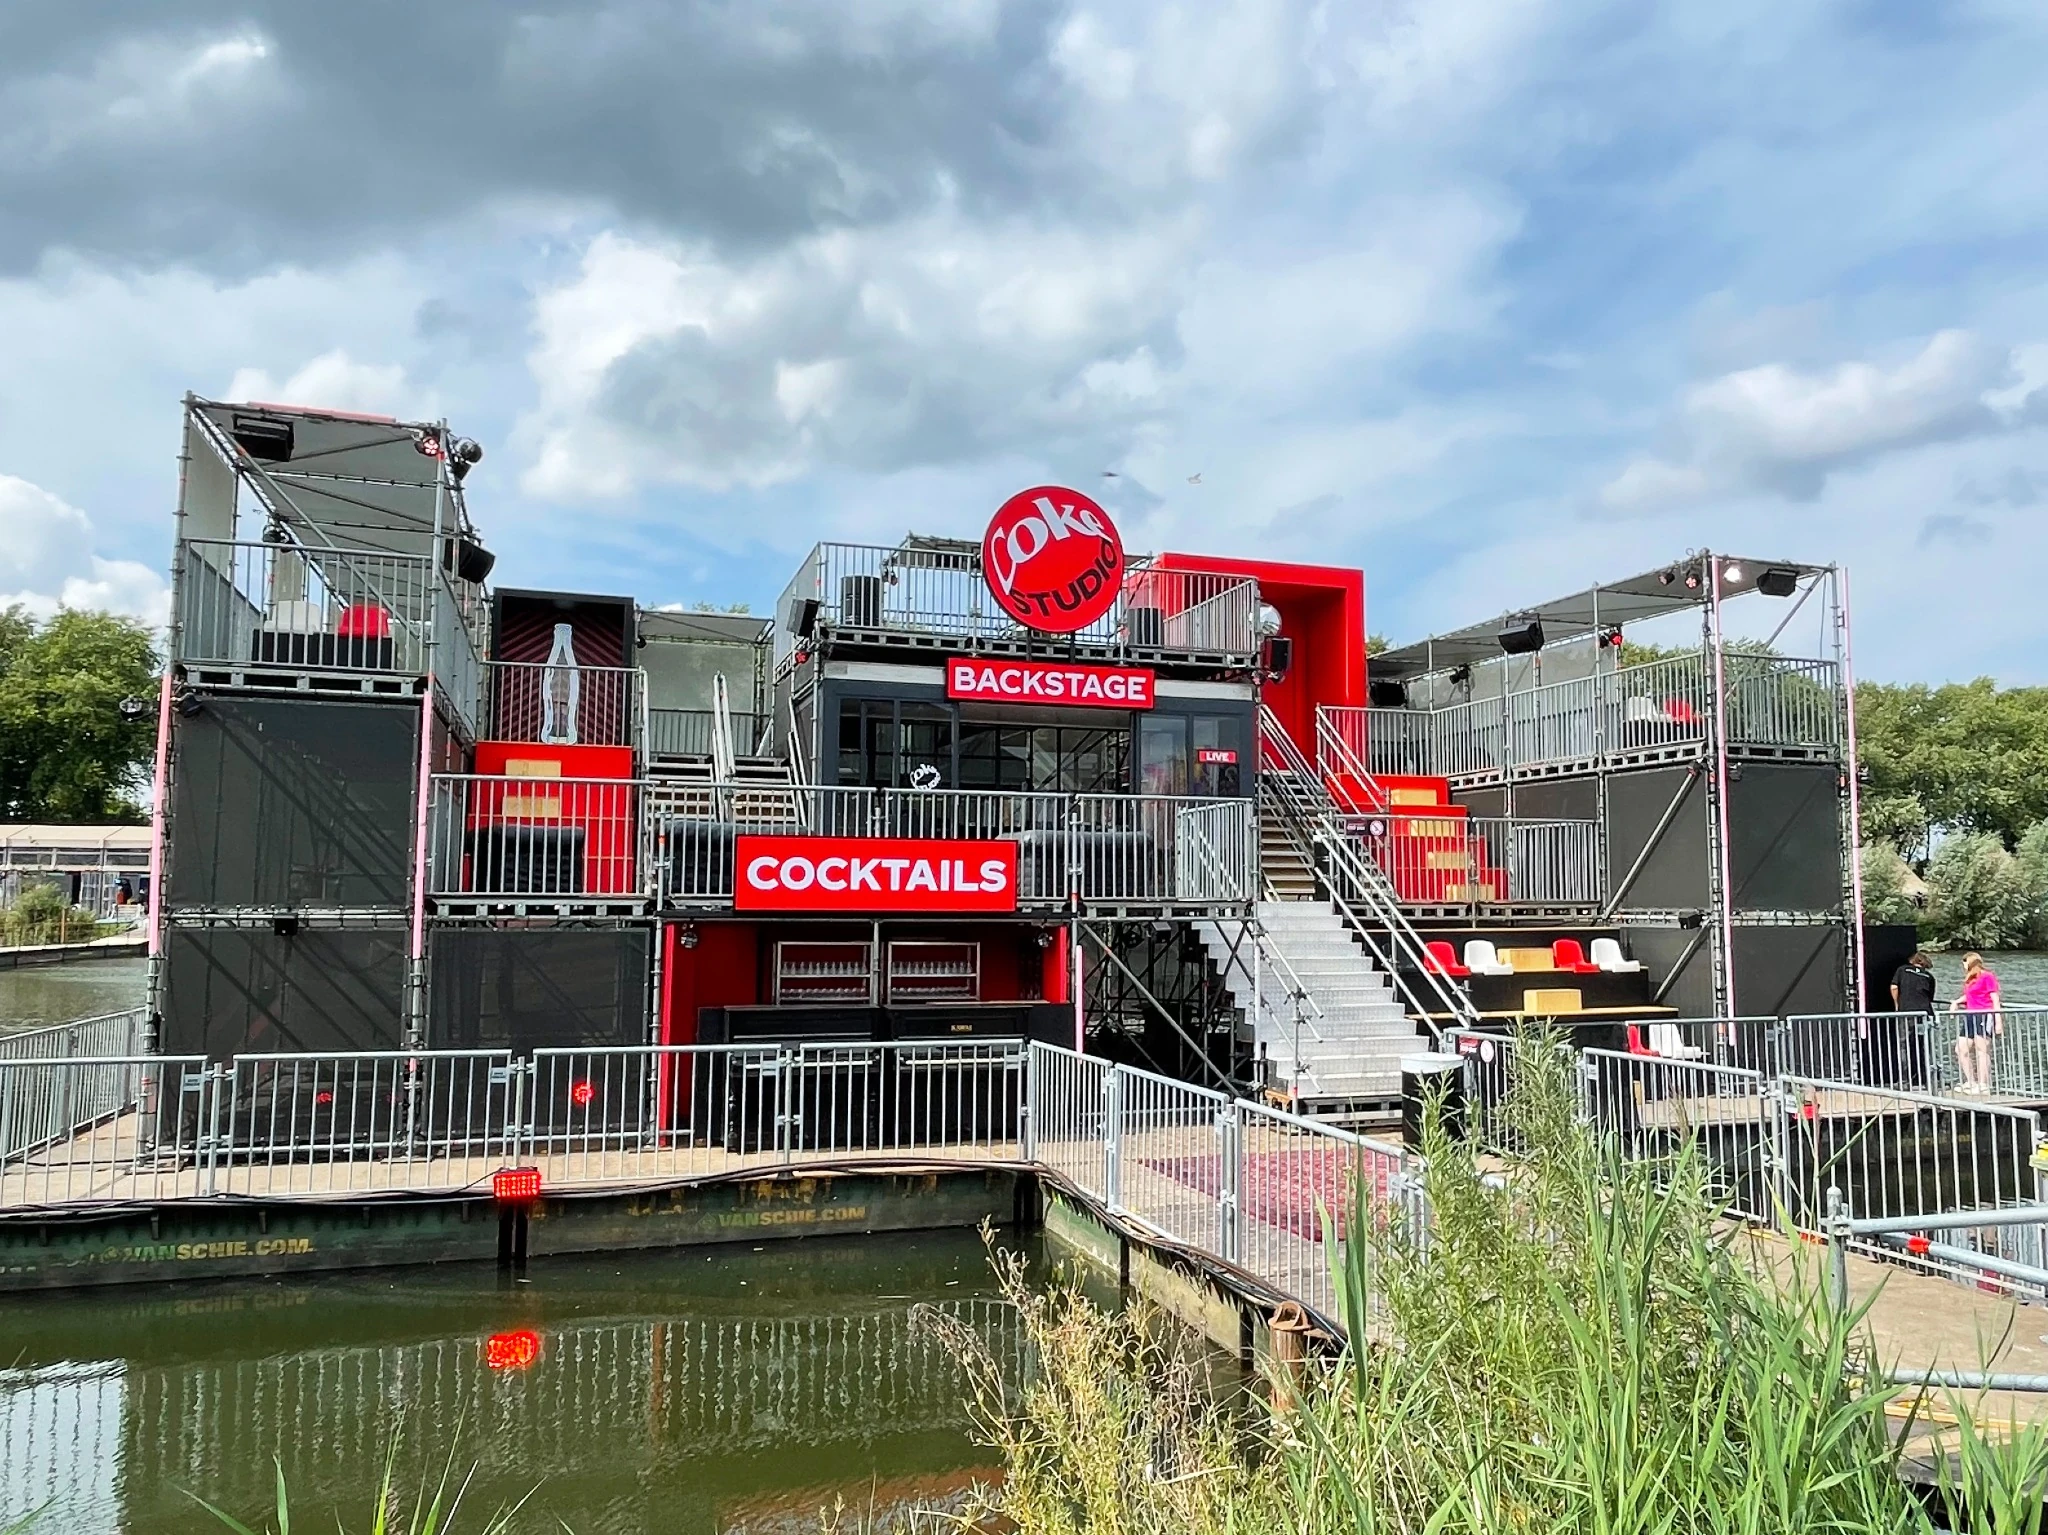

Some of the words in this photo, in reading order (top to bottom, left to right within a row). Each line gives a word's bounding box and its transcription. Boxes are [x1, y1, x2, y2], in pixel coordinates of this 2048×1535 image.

[990, 496, 1114, 596] Coke
[1009, 540, 1118, 617] STUDIO
[954, 665, 1147, 701] BACKSTAGE
[1206, 751, 1230, 762] LIVE
[746, 856, 1008, 893] COCKTAILS
[719, 1206, 866, 1228] VANSCHIE.COM
